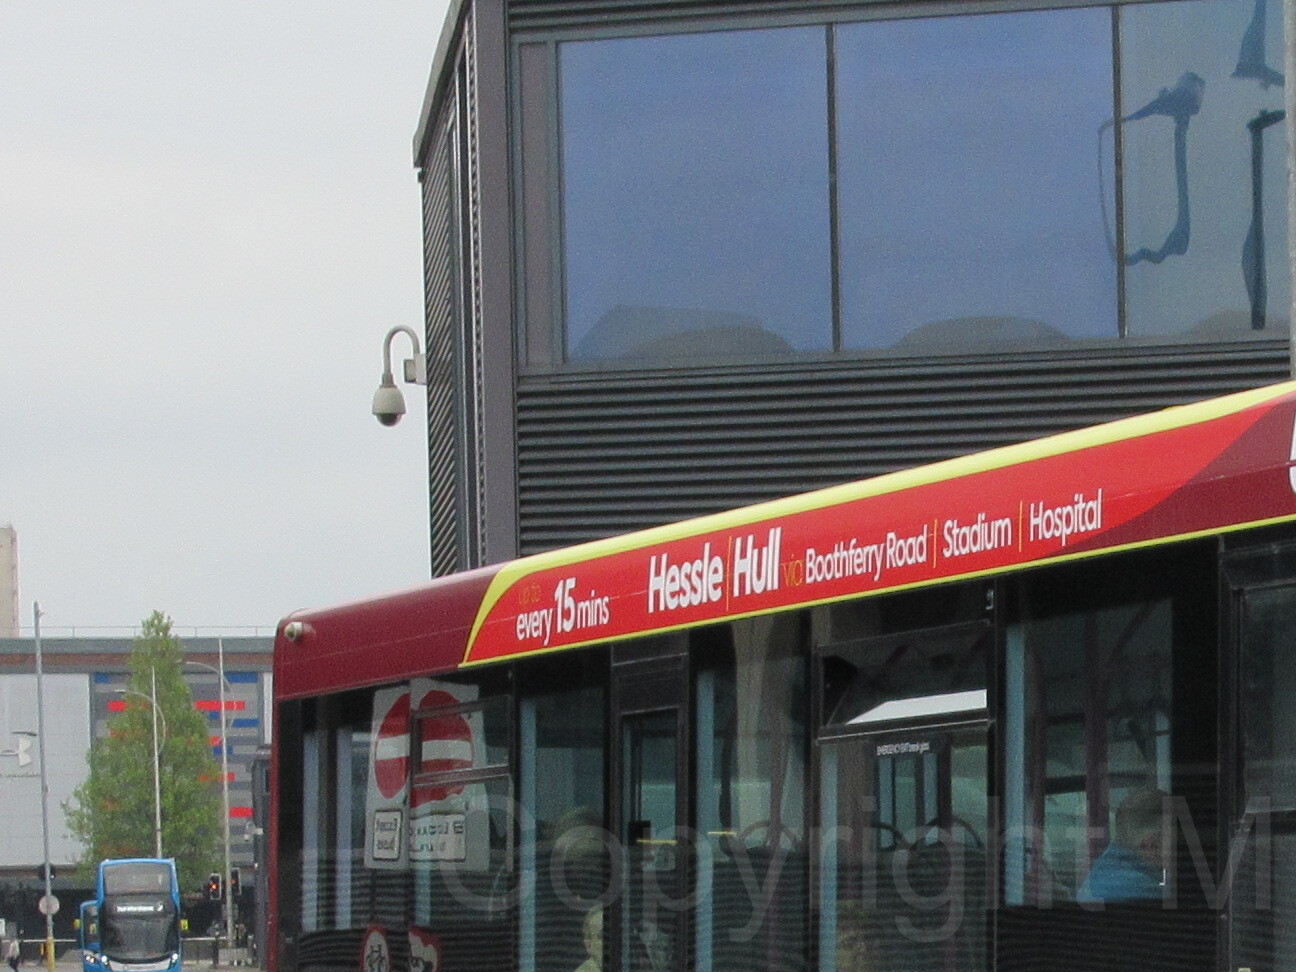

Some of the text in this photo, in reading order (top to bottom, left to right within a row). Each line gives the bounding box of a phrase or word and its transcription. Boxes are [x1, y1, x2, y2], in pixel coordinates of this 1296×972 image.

[648, 488, 1103, 614] Hessle Hull via Boothferry Road Stadium Hospital
[515, 577, 611, 646] every 15 mins
